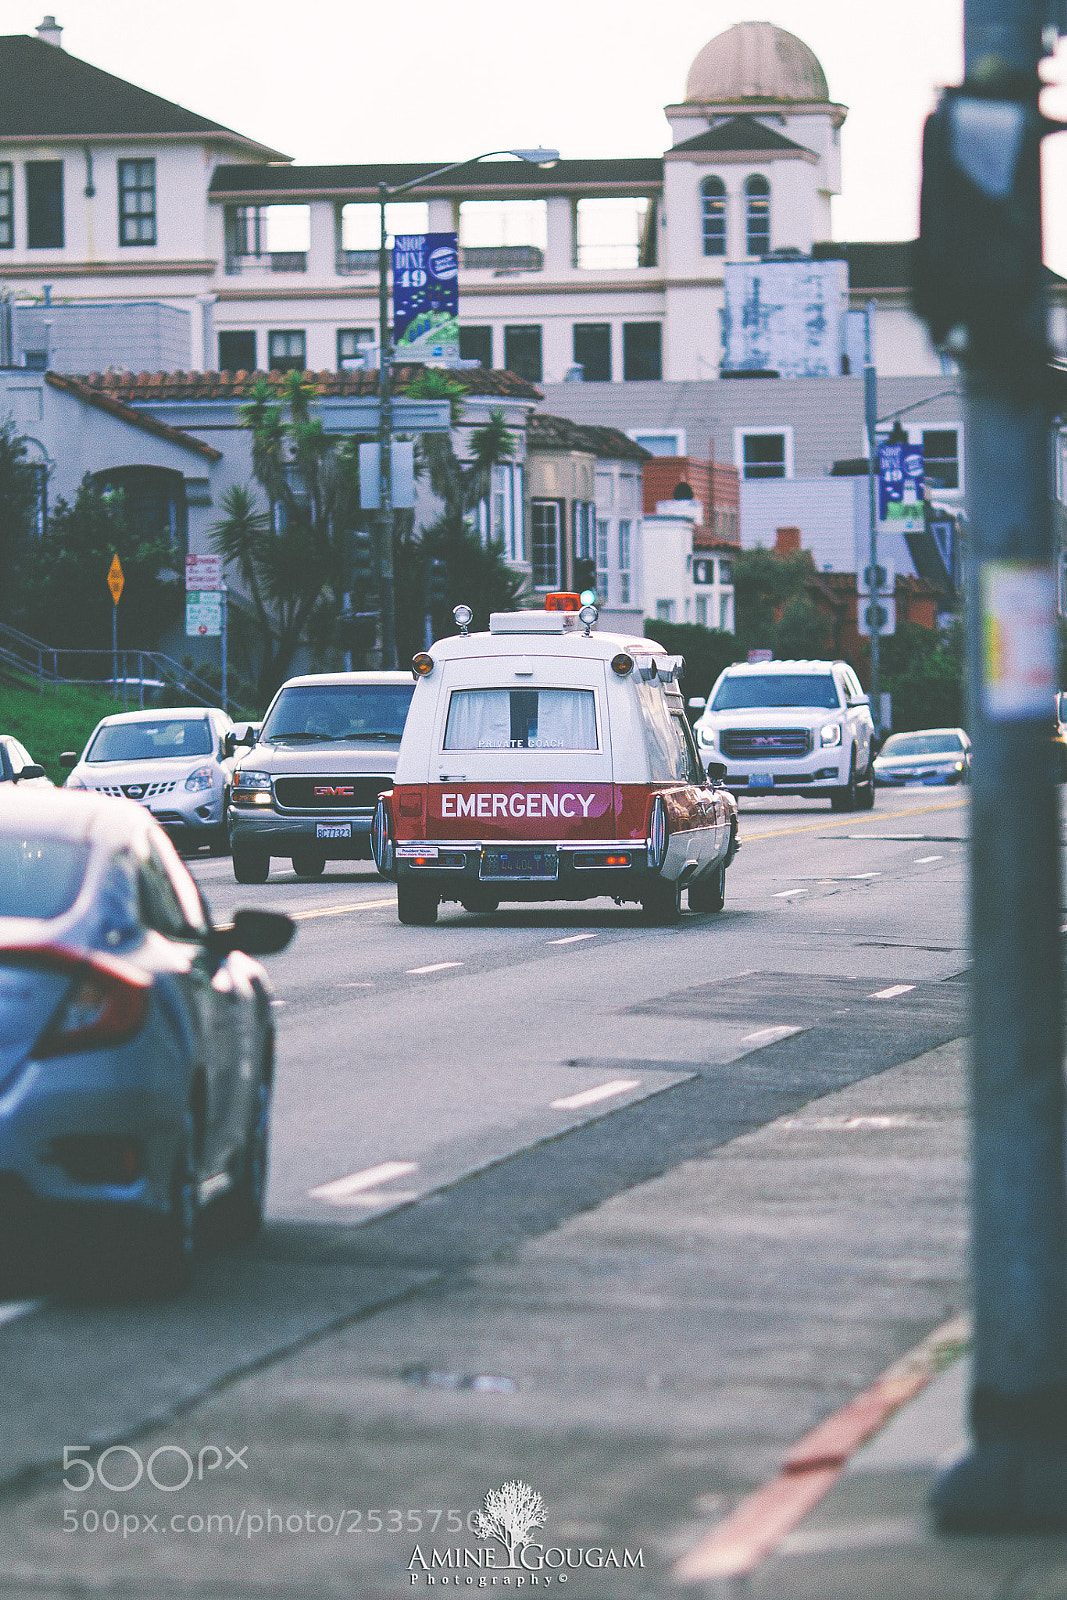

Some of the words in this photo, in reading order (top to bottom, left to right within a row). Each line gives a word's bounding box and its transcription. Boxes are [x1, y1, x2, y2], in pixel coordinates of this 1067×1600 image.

[395, 235, 426, 251] SHOP
[395, 252, 426, 269] DINE
[396, 269, 428, 288] 49
[478, 739, 524, 748] PRIVATE
[527, 739, 565, 748] COACH
[313, 785, 355, 796] GMC
[441, 792, 596, 818] EMERGENCY
